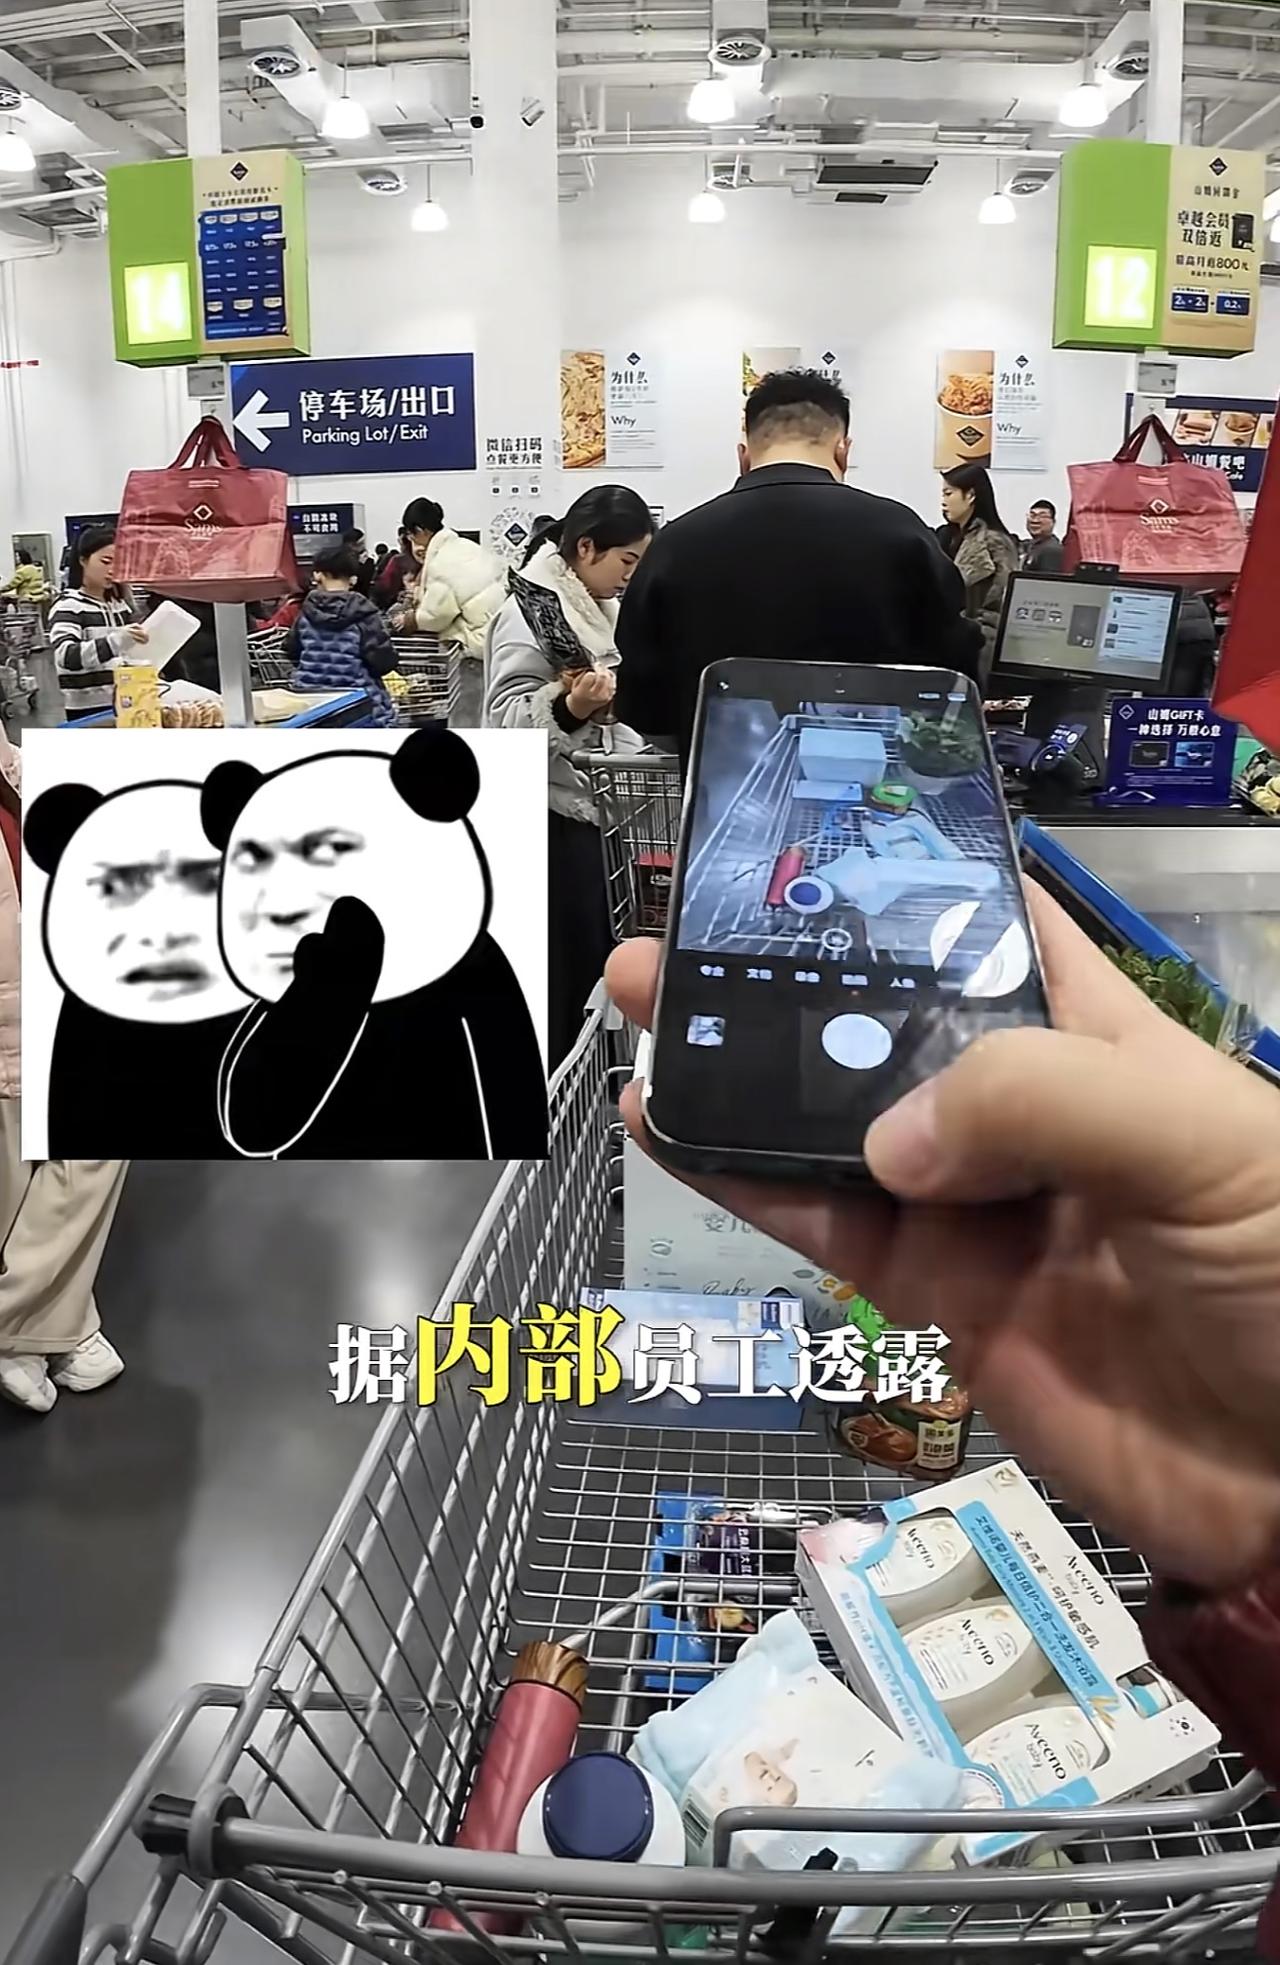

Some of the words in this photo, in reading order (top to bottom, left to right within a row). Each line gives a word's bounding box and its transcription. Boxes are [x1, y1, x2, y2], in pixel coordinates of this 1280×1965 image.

[1178, 210, 1230, 229] 卓越会员
[1094, 255, 1149, 320] 12
[133, 272, 184, 334] 14
[610, 370, 648, 385] 为什么
[300, 385, 455, 422] 停车场/出口
[611, 416, 636, 428] Why
[997, 423, 1021, 435] Why
[302, 426, 360, 446] Parking
[486, 437, 542, 452] 微信扫码
[1063, 1554, 1105, 1606] Aveeno
[1024, 1723, 1067, 1780] Aveeno
